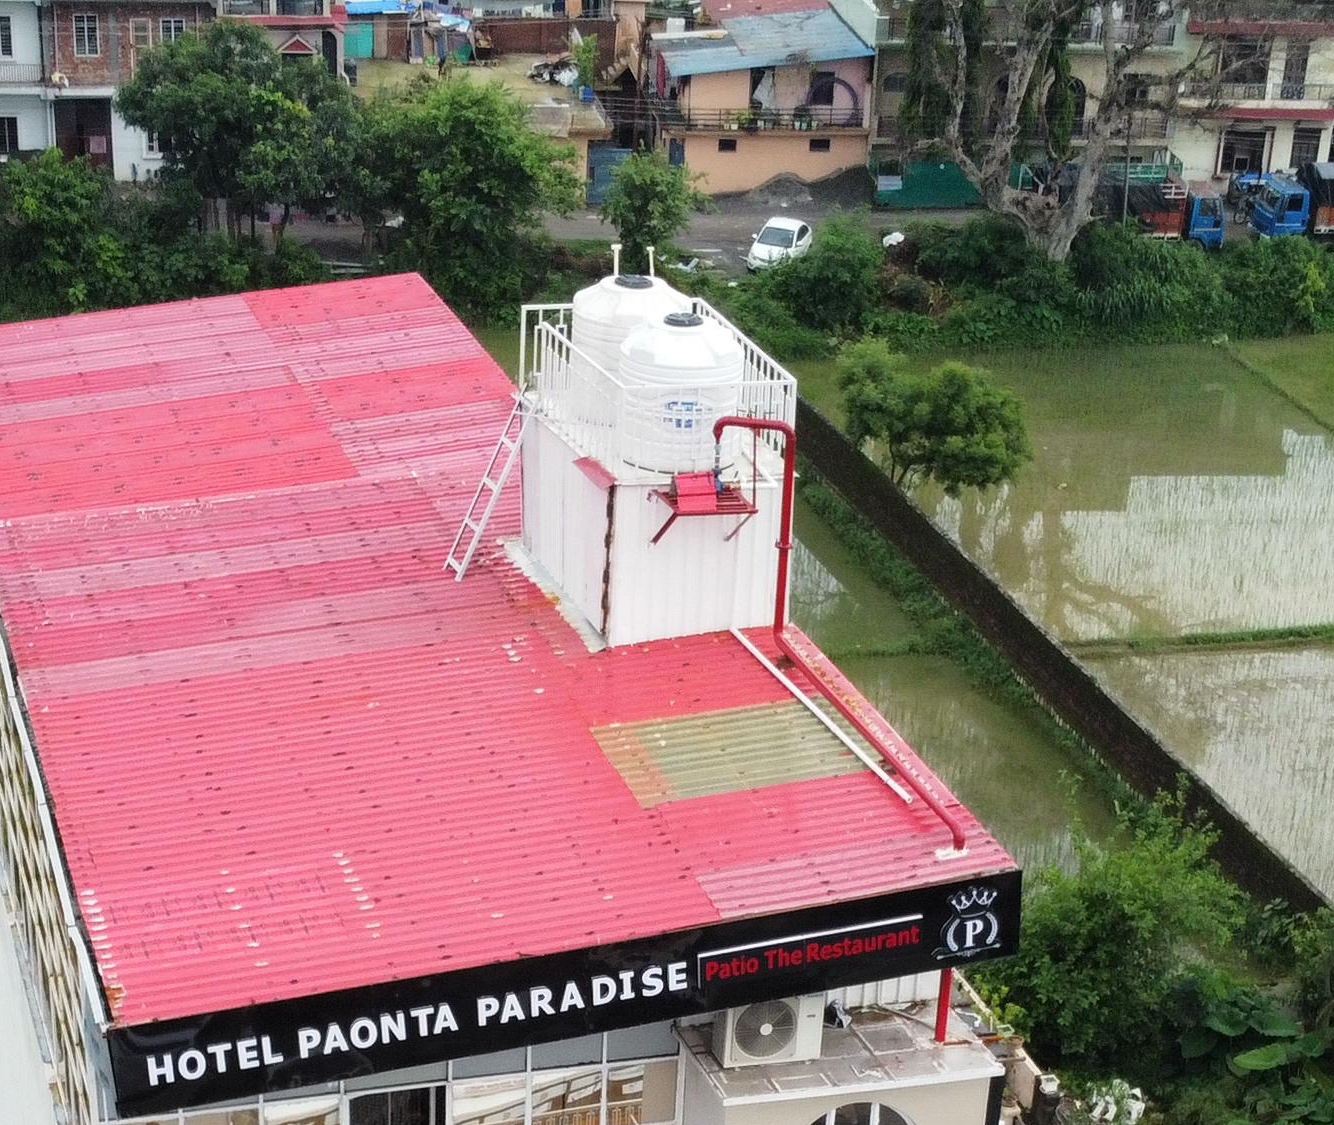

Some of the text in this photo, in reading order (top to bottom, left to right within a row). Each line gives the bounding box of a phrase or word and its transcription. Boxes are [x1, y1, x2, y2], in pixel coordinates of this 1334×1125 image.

[705, 926, 921, 981] Patio The Restaurant
[963, 918, 985, 948] P
[146, 961, 688, 1087] HOTEL PAONTA PARADISE
